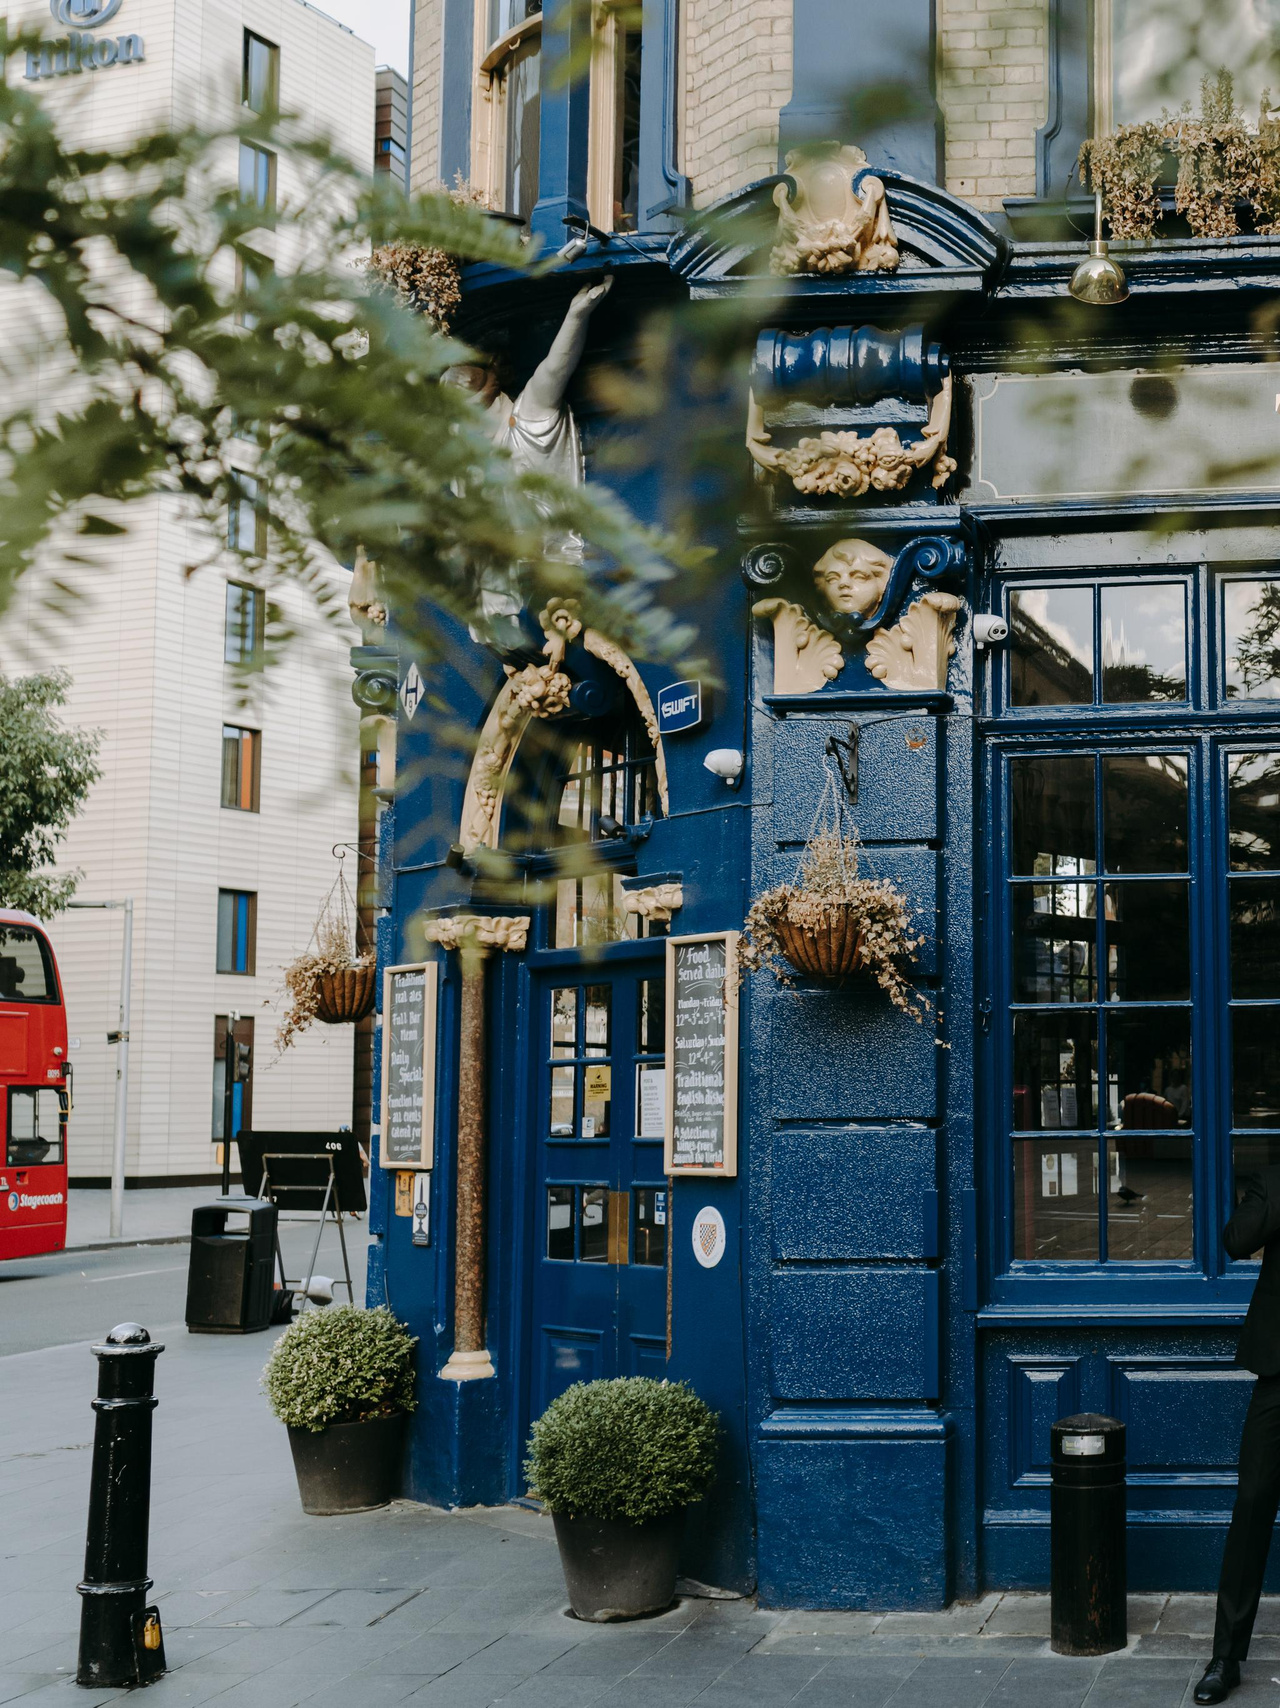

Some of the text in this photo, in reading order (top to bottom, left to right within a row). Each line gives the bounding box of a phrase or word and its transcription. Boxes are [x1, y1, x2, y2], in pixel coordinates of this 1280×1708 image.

[23, 31, 146, 81] Hilton
[404, 674, 419, 707] H
[662, 694, 698, 718] SWIFT
[686, 944, 711, 965] Food
[675, 1070, 725, 1088] Traditional
[19, 1192, 63, 1210] Stagecoach
